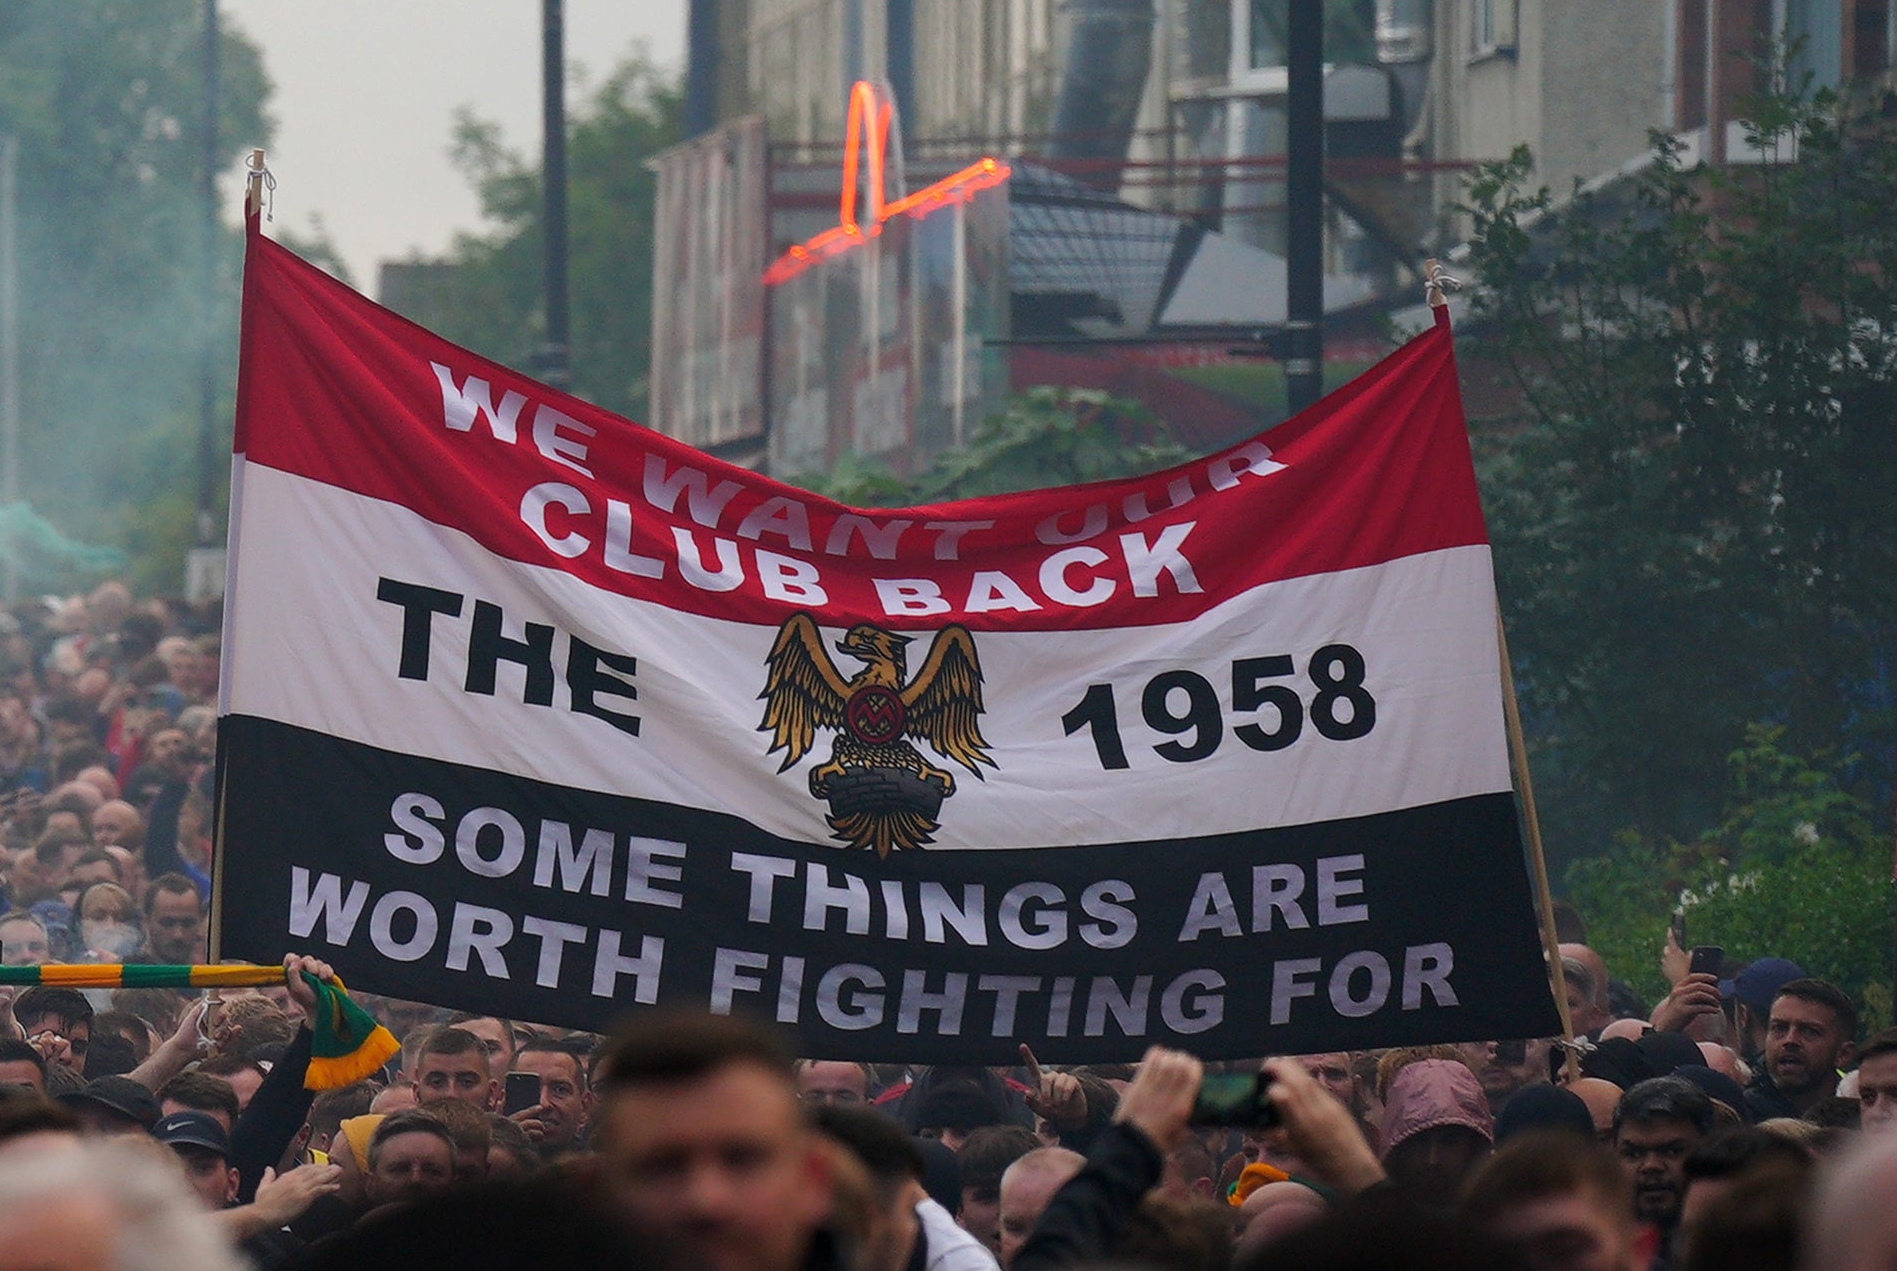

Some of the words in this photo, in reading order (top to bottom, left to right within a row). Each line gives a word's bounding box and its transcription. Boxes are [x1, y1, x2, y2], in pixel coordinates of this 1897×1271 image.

[429, 360, 600, 480] WE
[640, 454, 998, 561] WANT
[1034, 439, 1291, 546] OUR
[520, 481, 830, 608] CLUB
[872, 519, 1206, 618] BACK
[374, 576, 640, 737] THE
[1061, 643, 1377, 772] 1958
[286, 865, 666, 1007] WORTH
[710, 947, 1227, 1039] FIGHTING
[1268, 942, 1460, 1027] FOR
[382, 792, 687, 910] SOME
[731, 851, 1139, 952] THINGS
[1178, 853, 1371, 943] ARE
